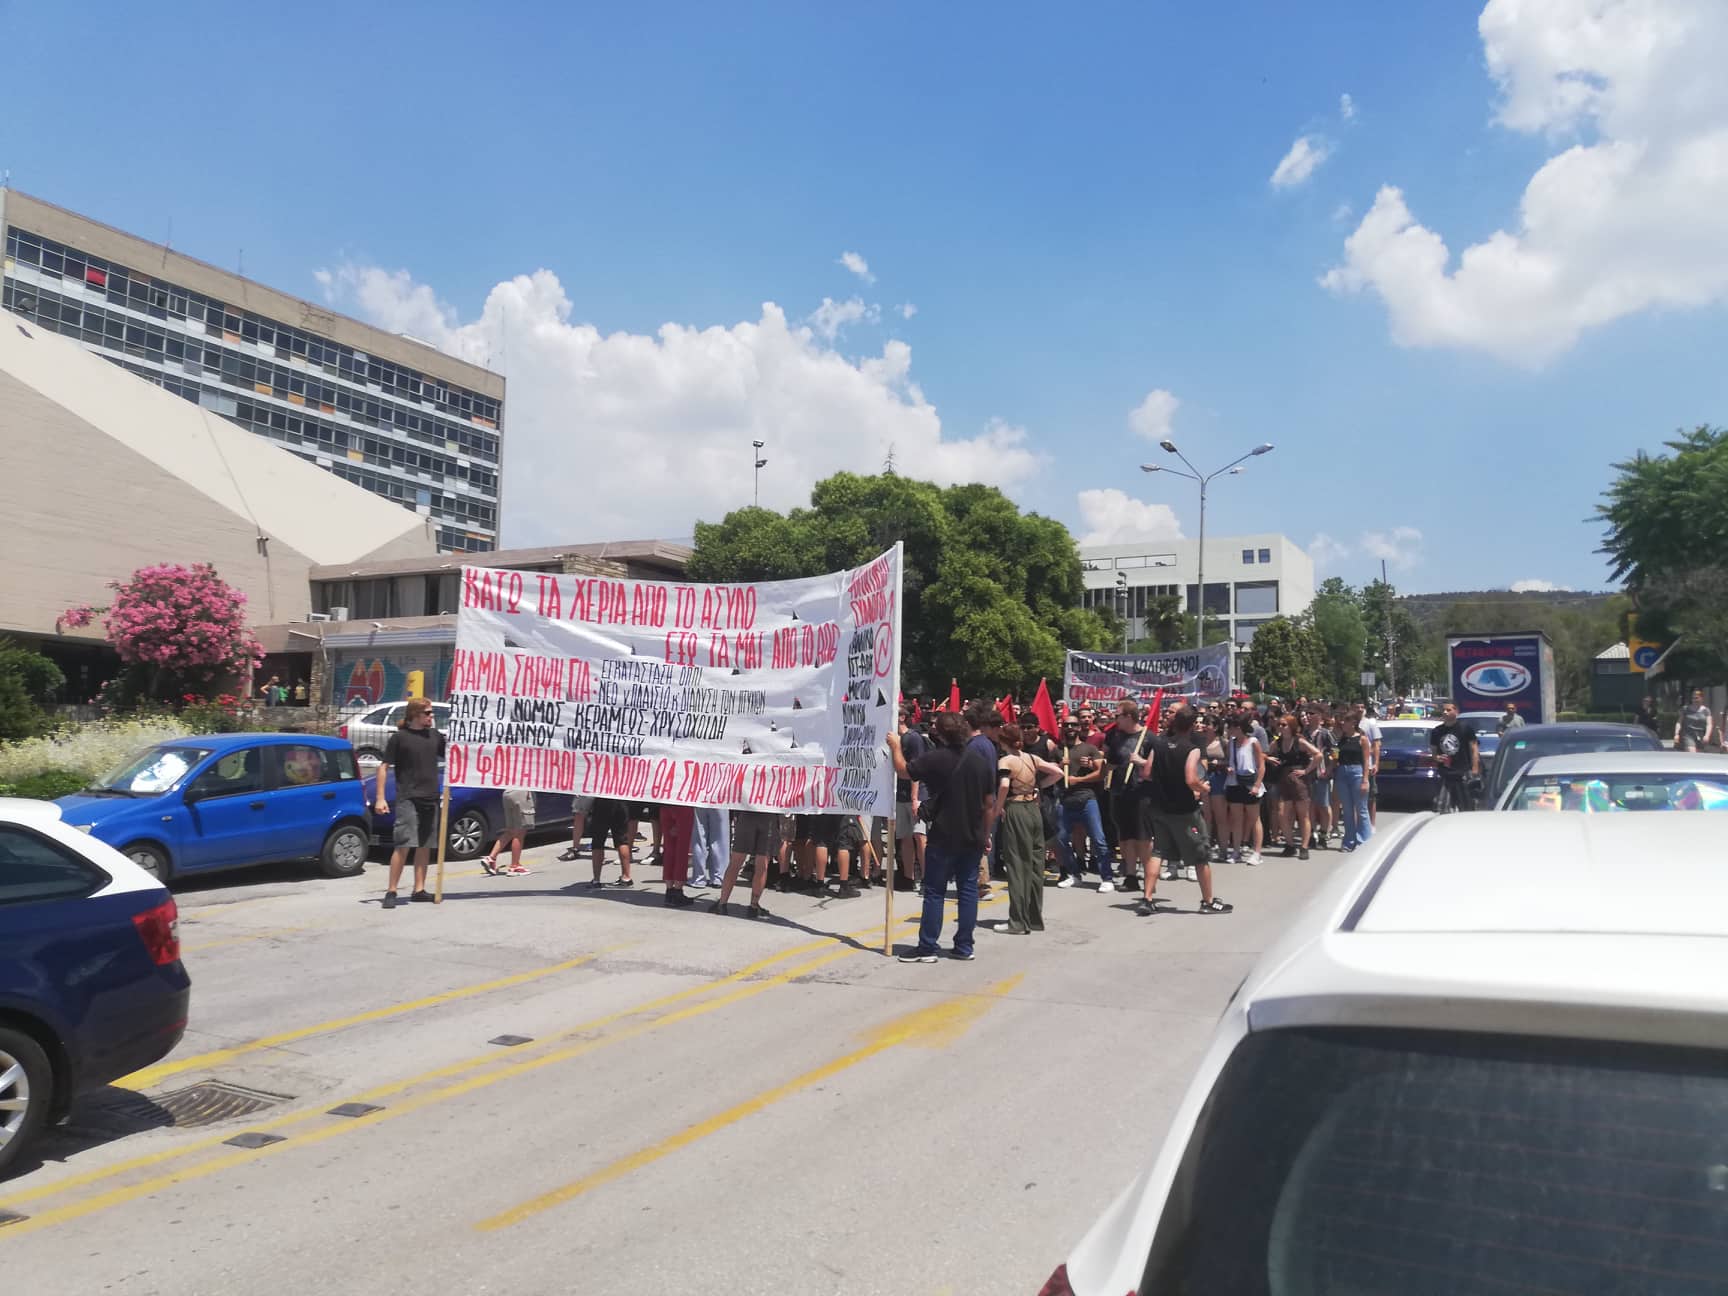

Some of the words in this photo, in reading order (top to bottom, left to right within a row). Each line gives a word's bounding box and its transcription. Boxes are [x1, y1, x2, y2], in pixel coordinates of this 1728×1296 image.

[464, 568, 523, 614] ΚΑΤΩ
[536, 575, 561, 619] ΤΑ
[569, 578, 627, 625] ΧΕΡΙΑ
[631, 583, 667, 628] ΑΠΟ
[673, 586, 697, 629] ΤΟ
[701, 586, 757, 630] ΑΣΥΛΟ
[665, 631, 697, 666] ΕΞΩ
[710, 632, 730, 668] ΤΑ
[735, 631, 766, 669] ΜΑΤ
[772, 627, 798, 669] ΑΠΟ
[802, 624, 815, 668] ΤΟ
[451, 648, 507, 695] ΚΑΜΙΑ
[512, 654, 564, 699] ΣΚΕΨΗ
[602, 659, 673, 685] ΕΓΚΑΤΑΣΤΑΣΗ
[450, 694, 488, 719] ΚΑΤΩ
[497, 697, 506, 720] Ο
[514, 699, 565, 727] ΝΟΜΟΣ
[599, 681, 618, 705] ΝΕΟ
[721, 689, 735, 715] ΤΩΝ
[448, 720, 555, 747] ΠΑΠΑΙΩΑΝΝΟΥ
[566, 728, 646, 756] ΠΑΡΑΙΤΗΣΟΥ
[450, 744, 469, 785] ΟΙ
[476, 745, 576, 790] ΦΟΙΤΗΤΙΚΟΙ
[582, 752, 651, 799] ΣΥΛΛΟΓΟΙ
[652, 758, 676, 800] ΘΑ
[676, 760, 748, 805] ΣΑΡΩΣΟΥΝ
[749, 766, 767, 805] ΤΑ
[766, 766, 807, 808] ΣΧΕΔΙΑ
